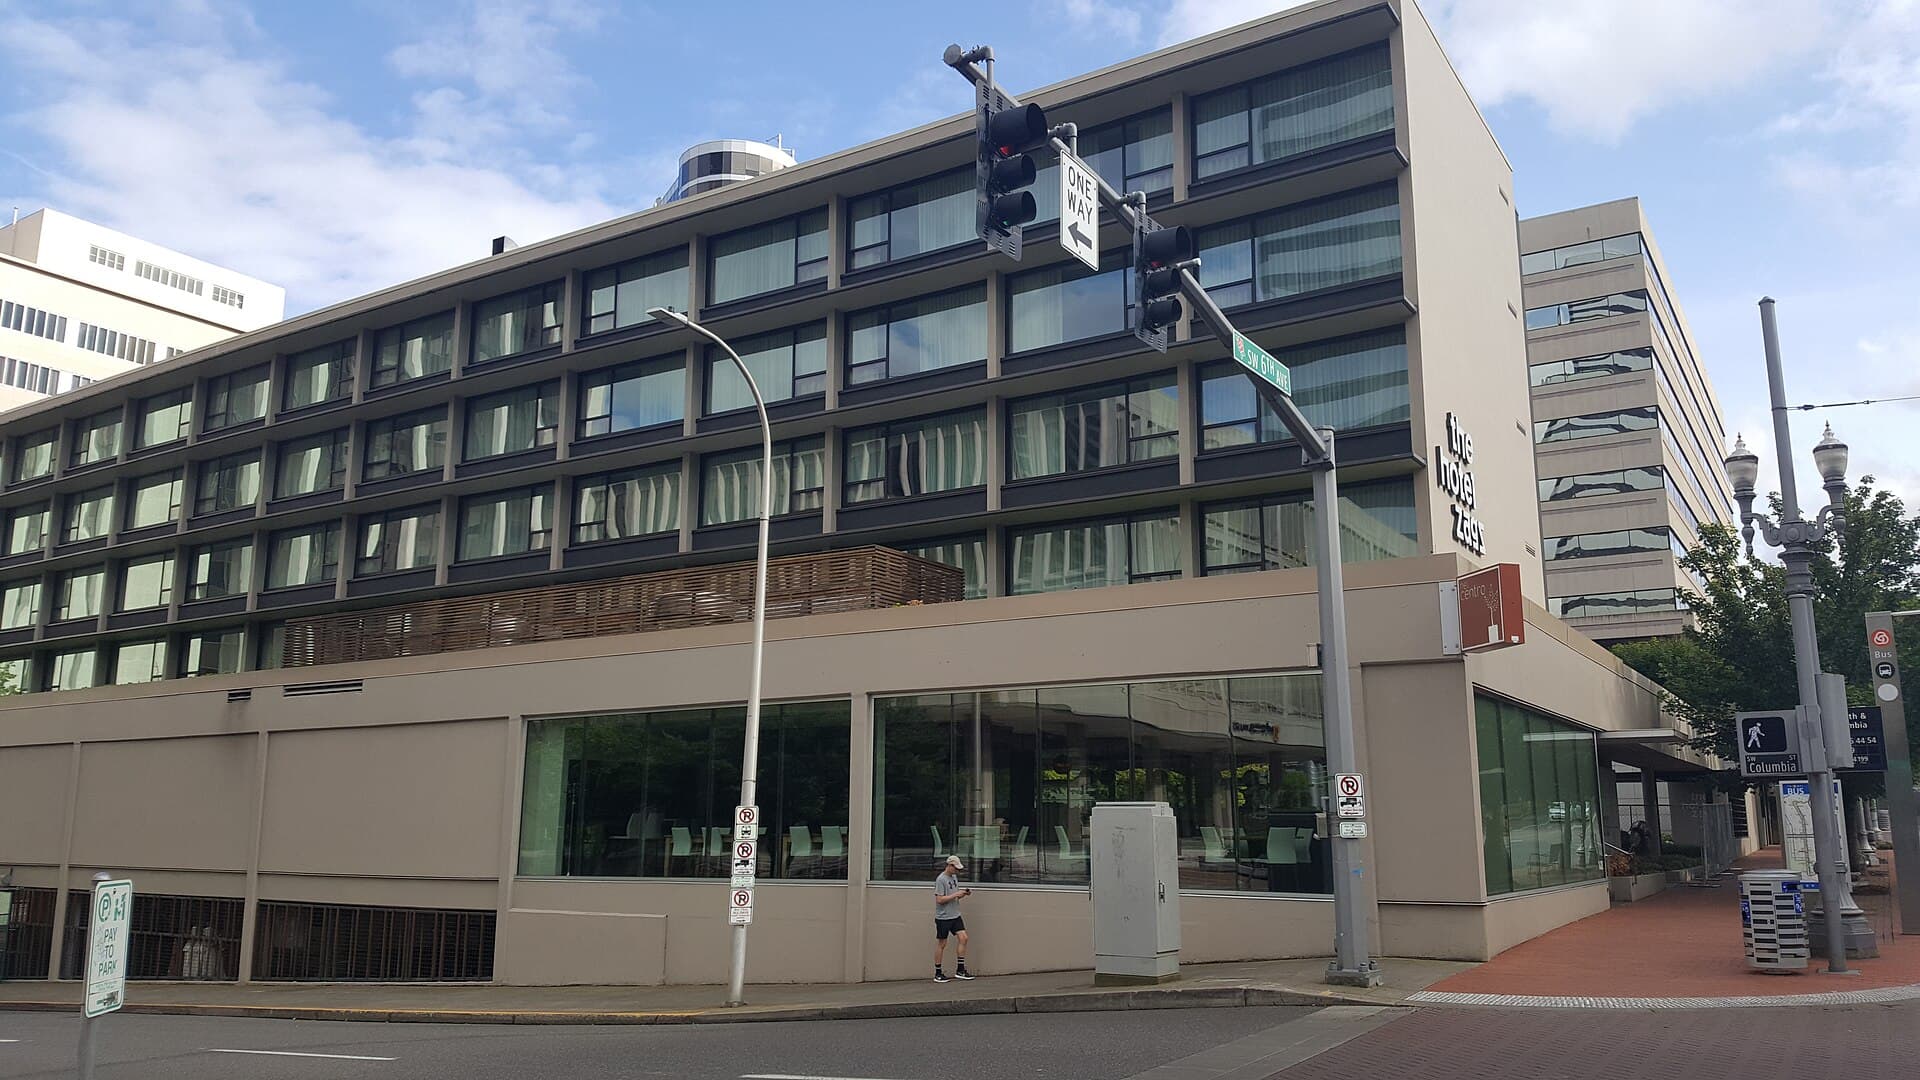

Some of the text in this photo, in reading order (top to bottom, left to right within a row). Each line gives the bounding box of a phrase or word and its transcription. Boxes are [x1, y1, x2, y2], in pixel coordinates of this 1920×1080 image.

[1068, 166, 1092, 201] ONE
[1067, 188, 1093, 225] WAY
[1247, 349, 1289, 391] SW 6TH AVE
[1446, 411, 1474, 465] the
[1435, 445, 1477, 511] hotel
[1450, 503, 1487, 558] zags
[1874, 650, 1892, 659] Bus
[1848, 712, 1867, 720] th &
[1848, 721, 1868, 729] mbia
[1749, 760, 1797, 773] Columbia
[1787, 787, 1805, 795] BUS
[103, 927, 118, 943] PAY
[104, 944, 114, 959] TO
[98, 960, 117, 977] PARK
